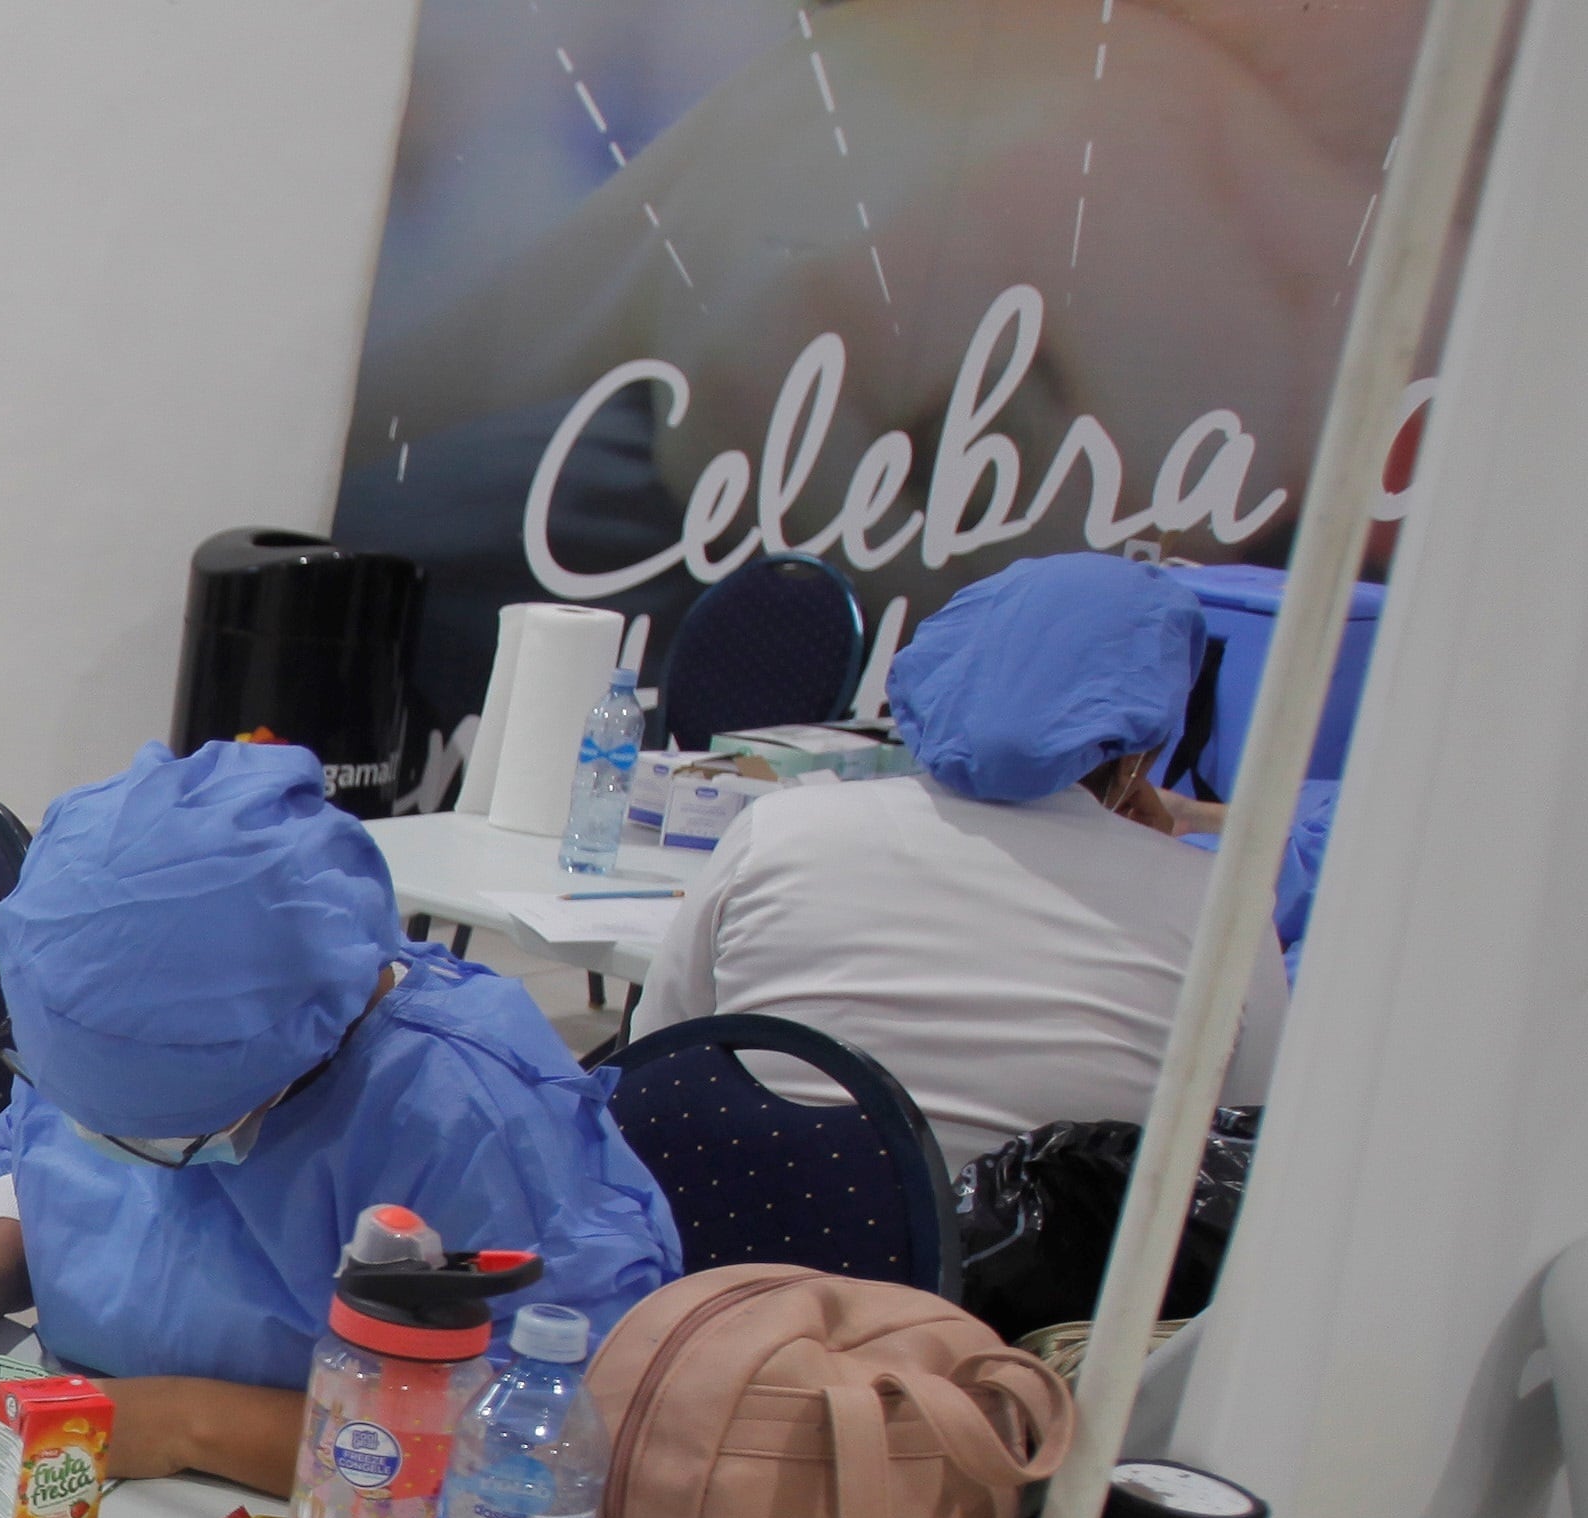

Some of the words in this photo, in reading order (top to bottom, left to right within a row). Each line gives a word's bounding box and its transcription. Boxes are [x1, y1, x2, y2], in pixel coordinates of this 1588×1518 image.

[522, 283, 1287, 600] Celebra
[323, 752, 399, 799] gamall
[342, 1449, 387, 1465] FREEZE
